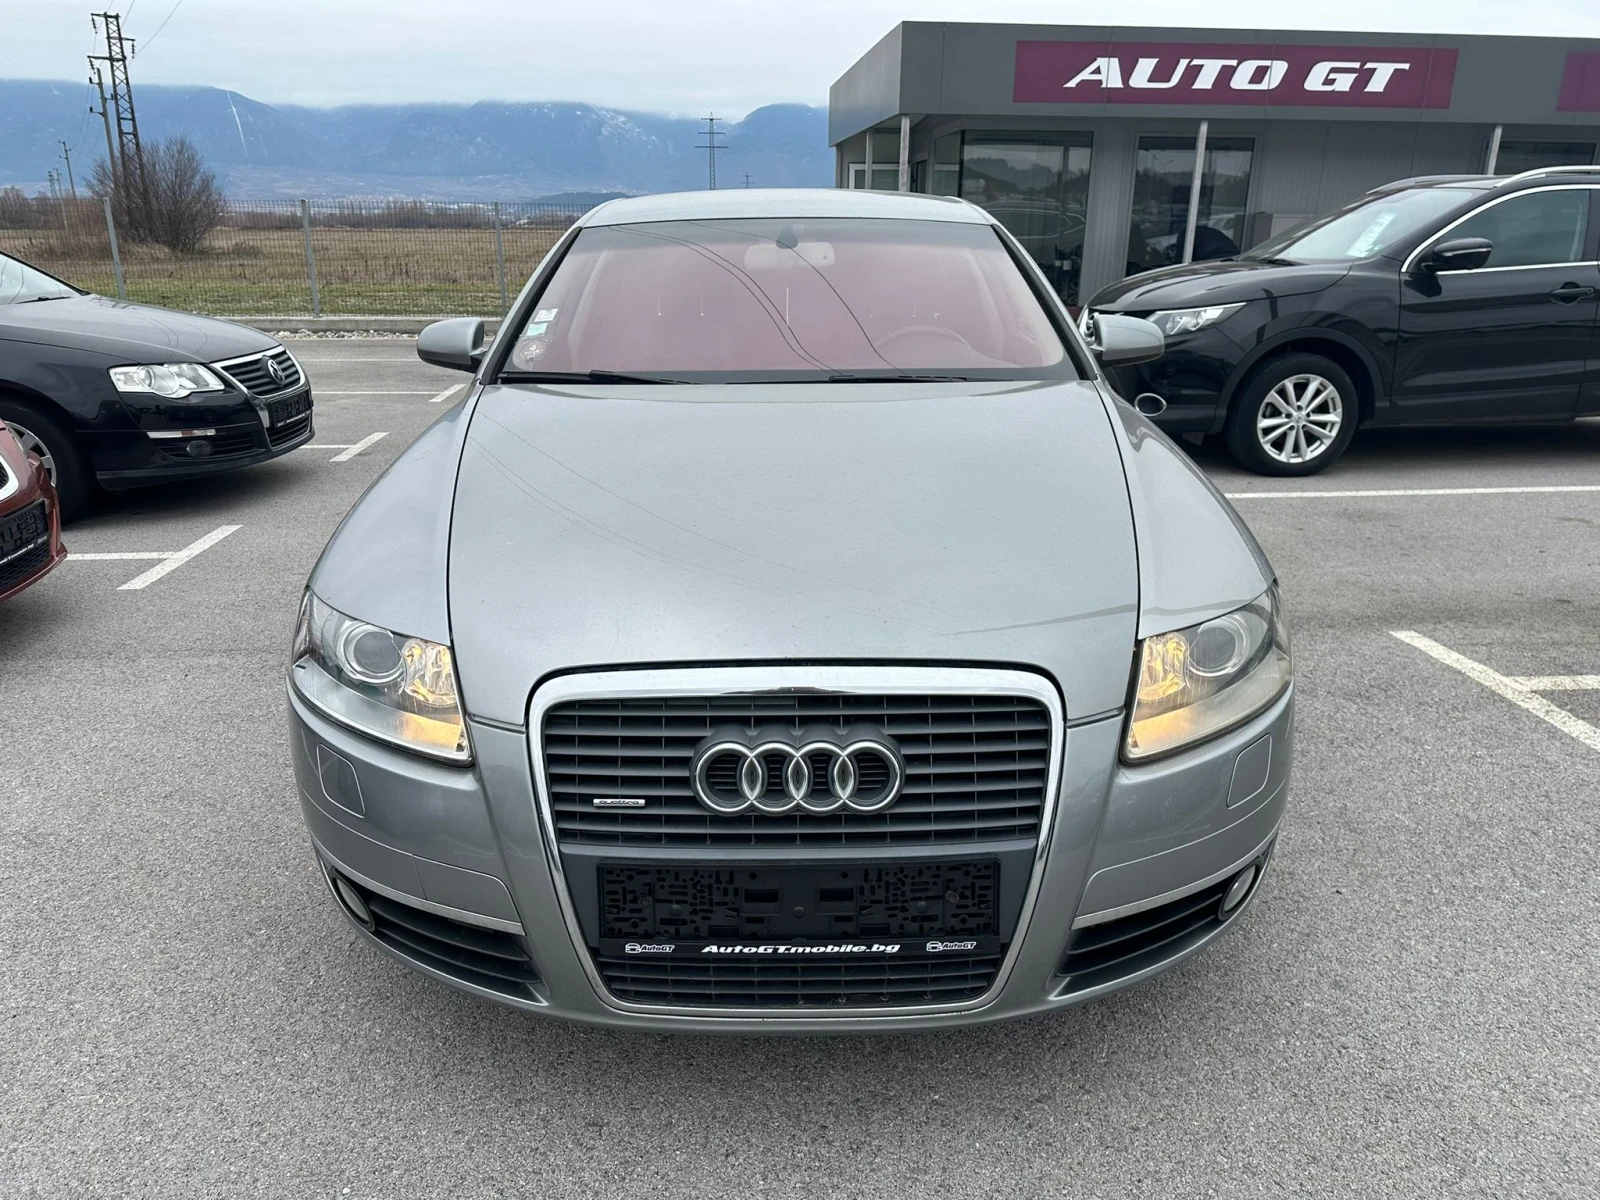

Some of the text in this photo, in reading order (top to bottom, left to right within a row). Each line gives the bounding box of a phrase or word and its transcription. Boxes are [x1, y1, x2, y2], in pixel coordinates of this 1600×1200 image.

[1062, 57, 1411, 92] AUTO GT
[640, 944, 674, 952] AutoGT
[941, 941, 976, 950] AutoGT
